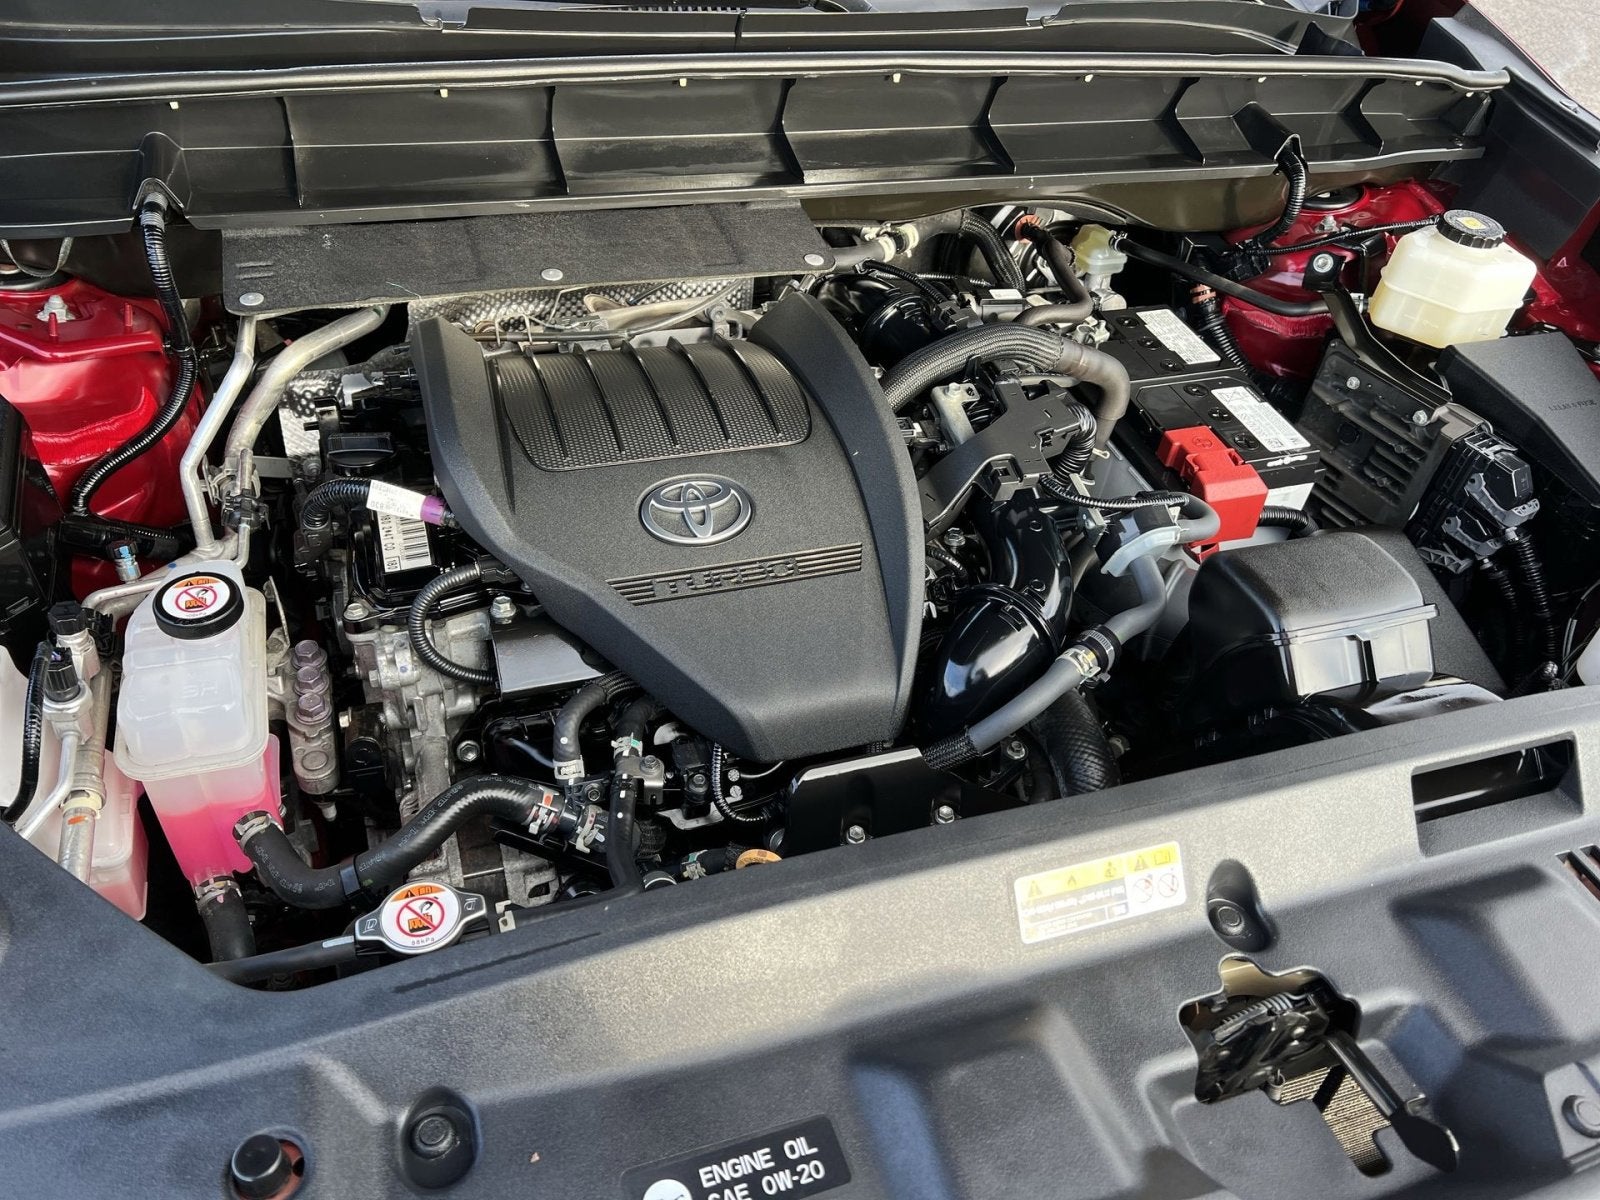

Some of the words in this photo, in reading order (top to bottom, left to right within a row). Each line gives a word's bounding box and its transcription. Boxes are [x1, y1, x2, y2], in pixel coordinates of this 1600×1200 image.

[654, 558, 796, 595] TURBO
[698, 1147, 775, 1188] ENGINE
[783, 1136, 818, 1160] OIL
[761, 1160, 826, 1195] 0W-20
